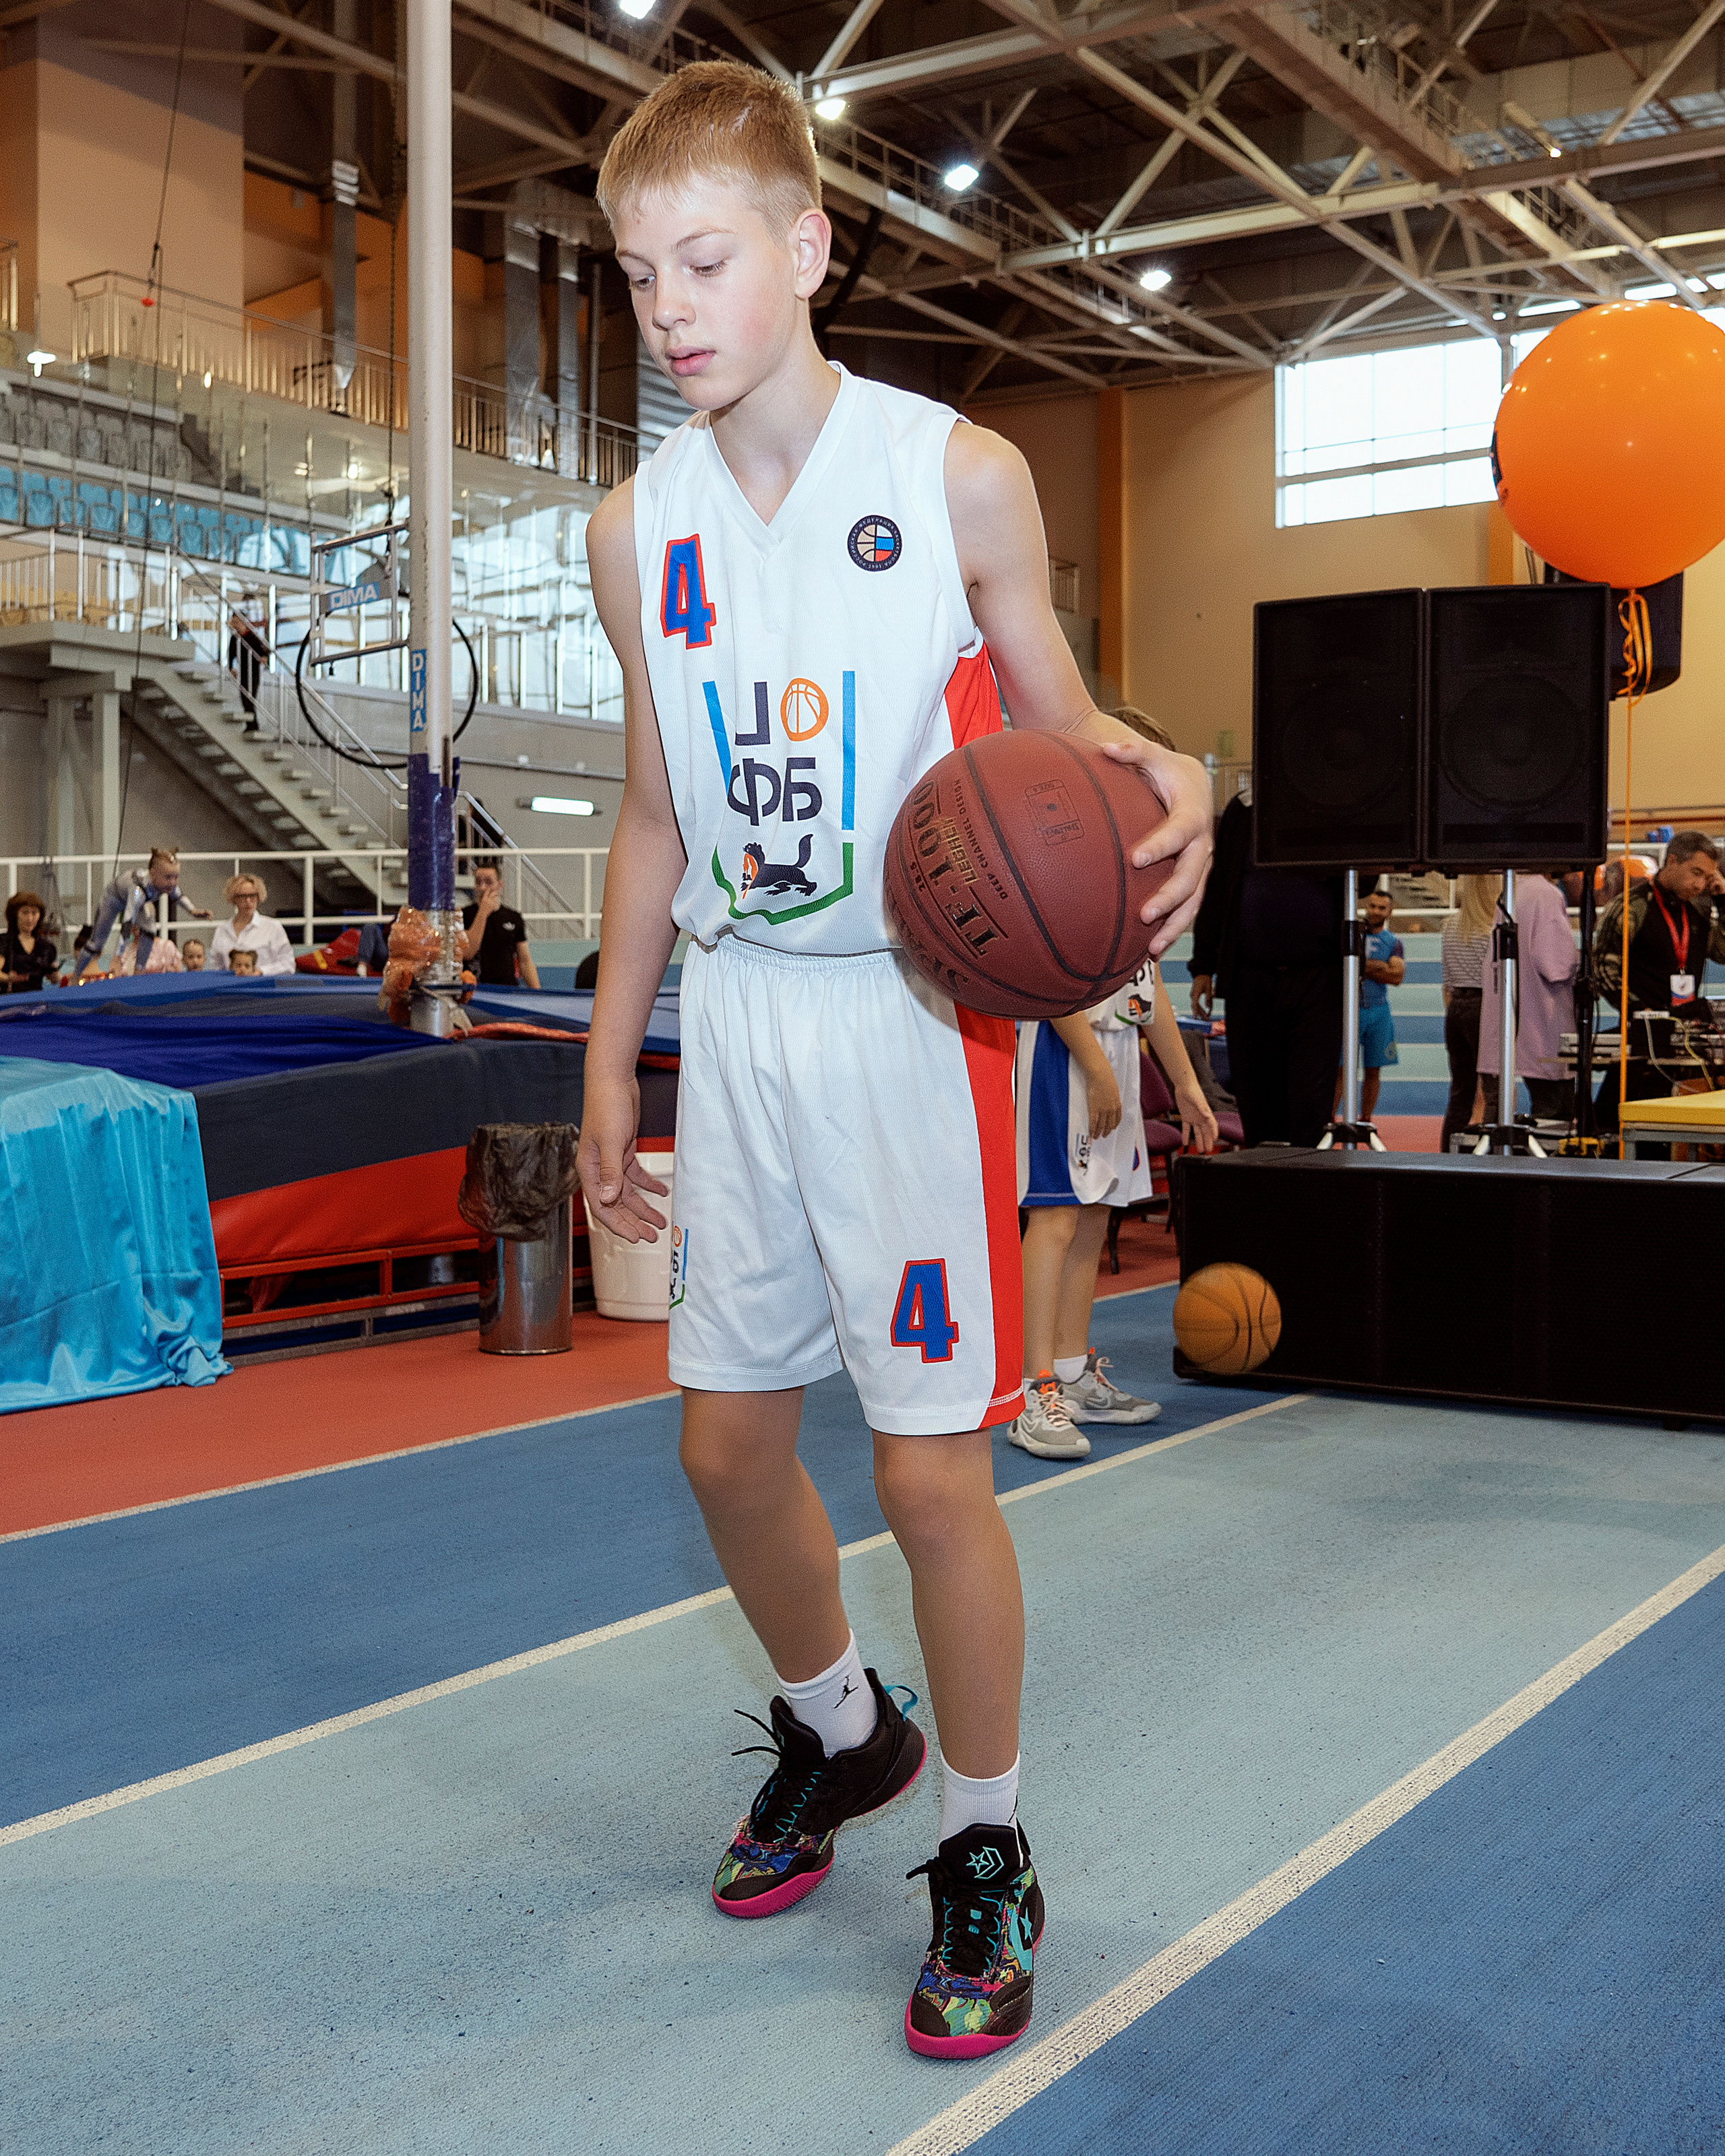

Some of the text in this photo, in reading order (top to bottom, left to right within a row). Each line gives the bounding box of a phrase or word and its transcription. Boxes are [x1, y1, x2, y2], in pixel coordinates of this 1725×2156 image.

[331, 584, 378, 608] DIMA
[660, 533, 717, 650] 4
[412, 652, 426, 730] DIMA
[727, 757, 822, 827] ФБ
[910, 862, 927, 892] 28.5
[914, 780, 999, 957] TF-1000
[953, 778, 1008, 900] DEEP CHANNEL DESIGN
[890, 1258, 960, 1364] 4
